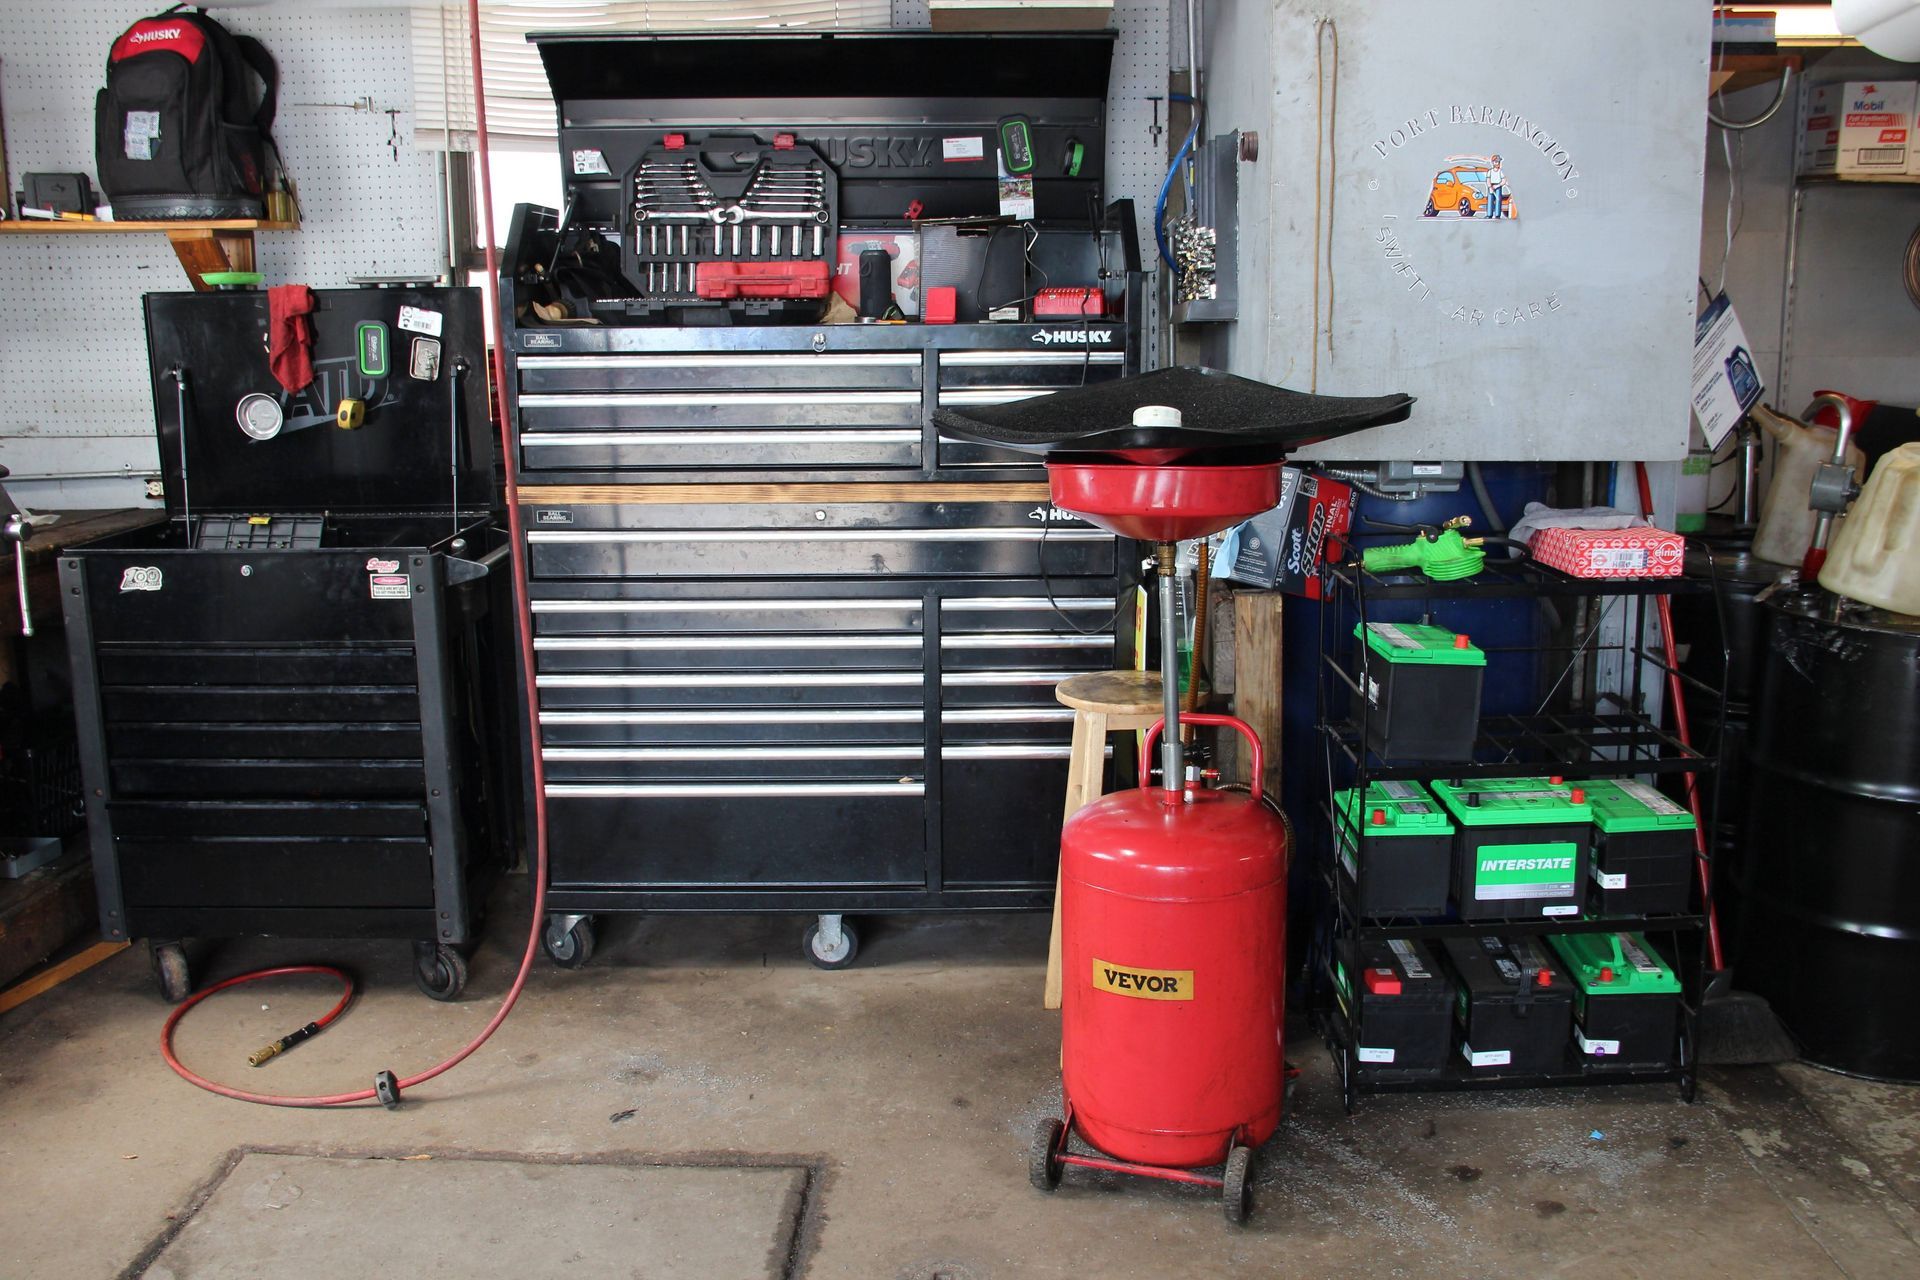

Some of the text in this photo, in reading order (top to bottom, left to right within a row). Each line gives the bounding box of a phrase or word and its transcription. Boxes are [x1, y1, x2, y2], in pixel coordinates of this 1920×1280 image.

[142, 28, 181, 42] HUSKY
[1853, 101, 1885, 111] Mobil
[1371, 104, 1579, 183] PORT BARRINGTON
[1494, 292, 1562, 325] CARE
[1053, 330, 1111, 343] HUSKY
[1287, 527, 1302, 575] Scott
[1301, 502, 1325, 577] SHOP
[1480, 857, 1573, 872] INTERSTATE
[1104, 968, 1178, 993] VEVOR
